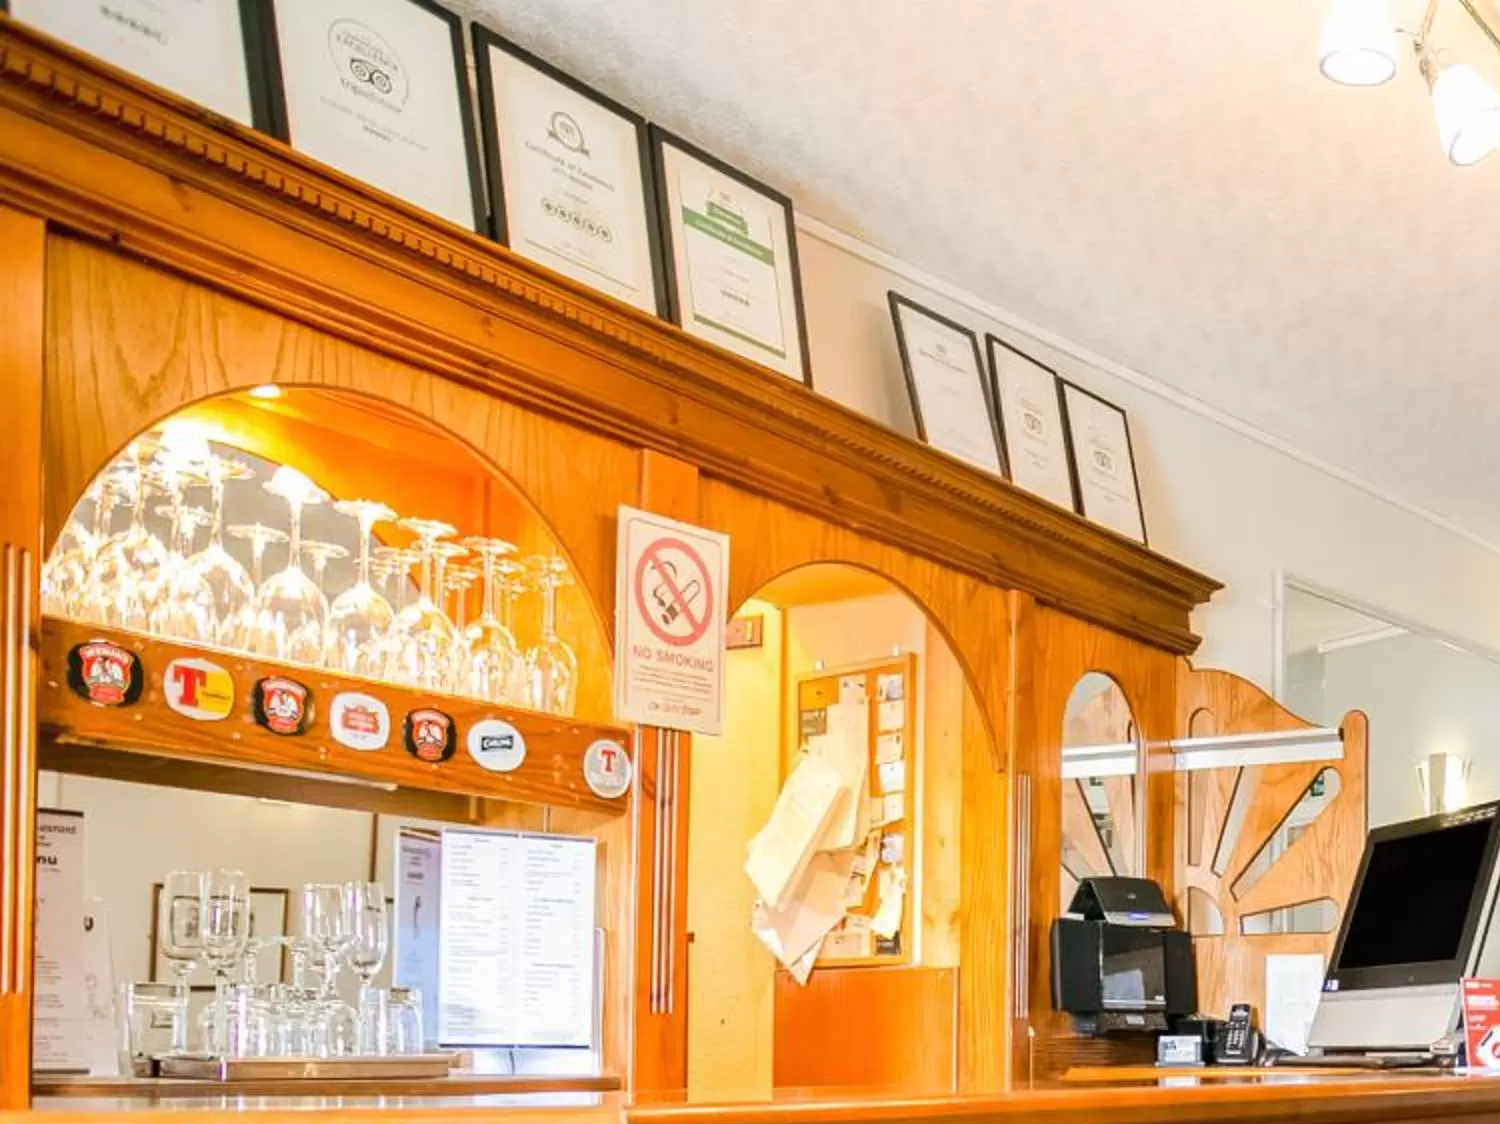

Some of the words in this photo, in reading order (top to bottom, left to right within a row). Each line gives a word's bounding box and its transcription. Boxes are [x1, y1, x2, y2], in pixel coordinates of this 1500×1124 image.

[632, 644, 653, 661] NO
[655, 649, 715, 673] SMOKING
[173, 664, 208, 708] T
[600, 749, 617, 773] T
[36, 854, 58, 866] nu
